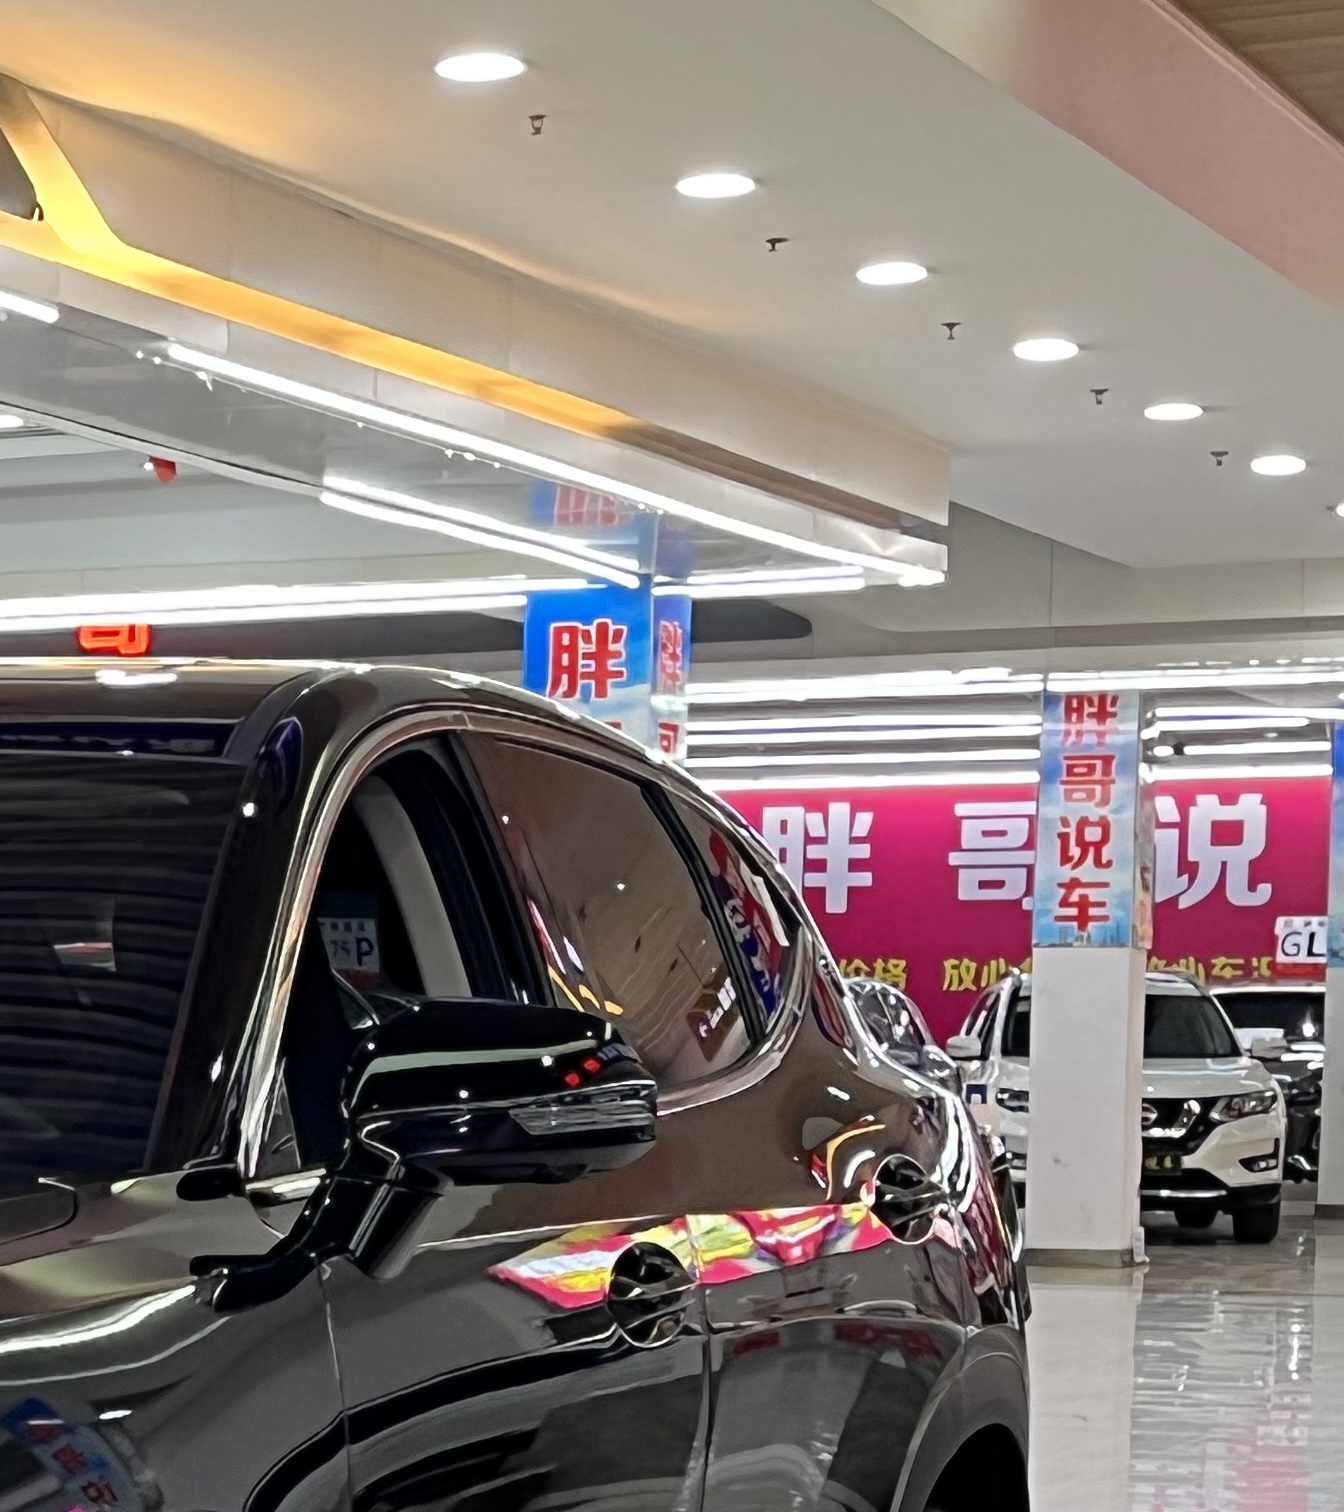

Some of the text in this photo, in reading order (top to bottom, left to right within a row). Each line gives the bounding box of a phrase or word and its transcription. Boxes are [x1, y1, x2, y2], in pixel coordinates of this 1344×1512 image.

[546, 618, 628, 731] 胖
[1053, 692, 1120, 933] 胖哥说车
